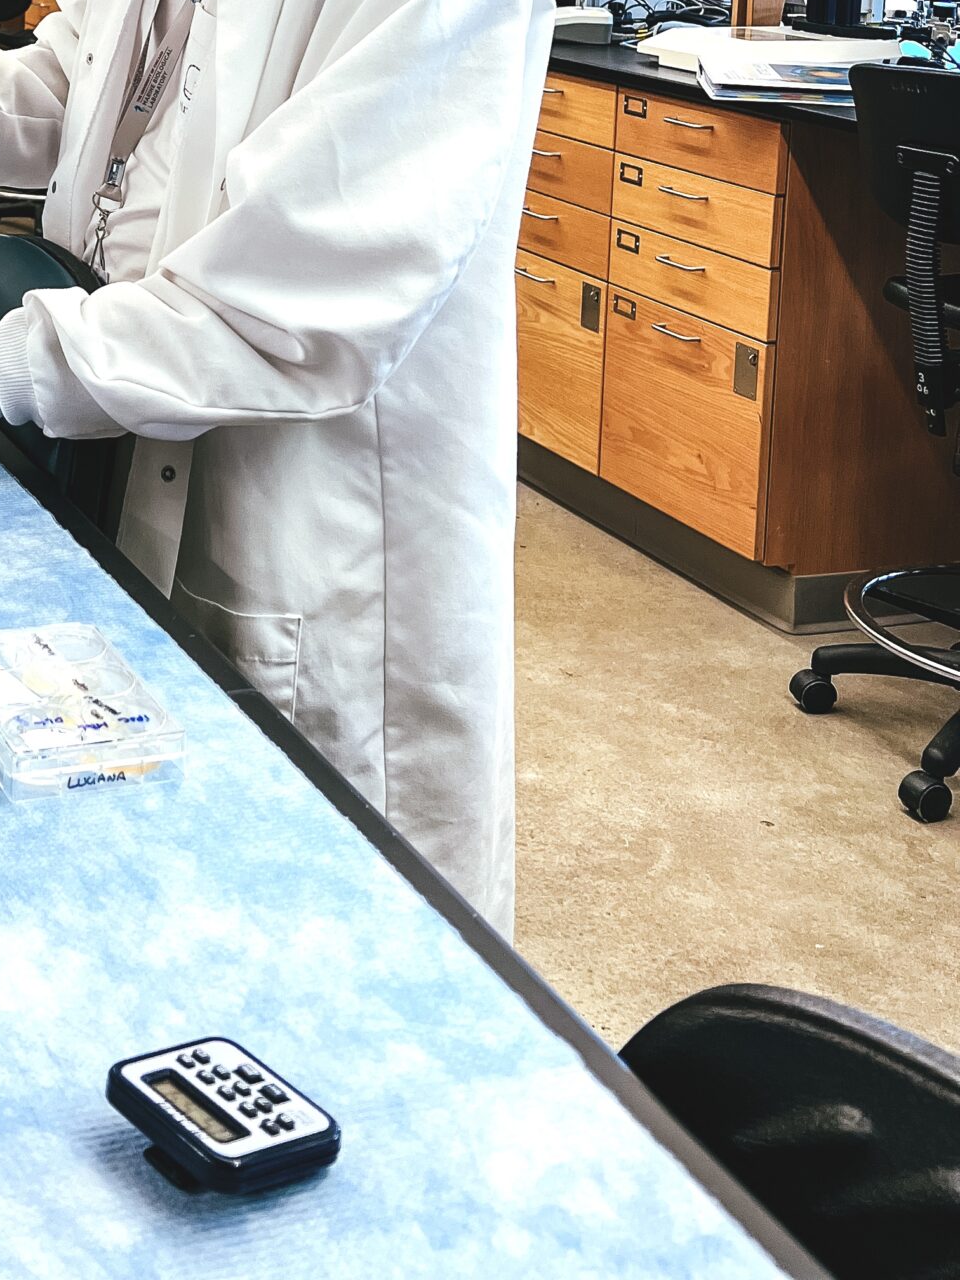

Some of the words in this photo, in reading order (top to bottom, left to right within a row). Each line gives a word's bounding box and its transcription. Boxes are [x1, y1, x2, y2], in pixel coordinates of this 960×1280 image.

[142, 83, 156, 106] MARINE
[152, 48, 173, 84] BIOLOGICAL
[147, 70, 168, 109] LABORATORY
